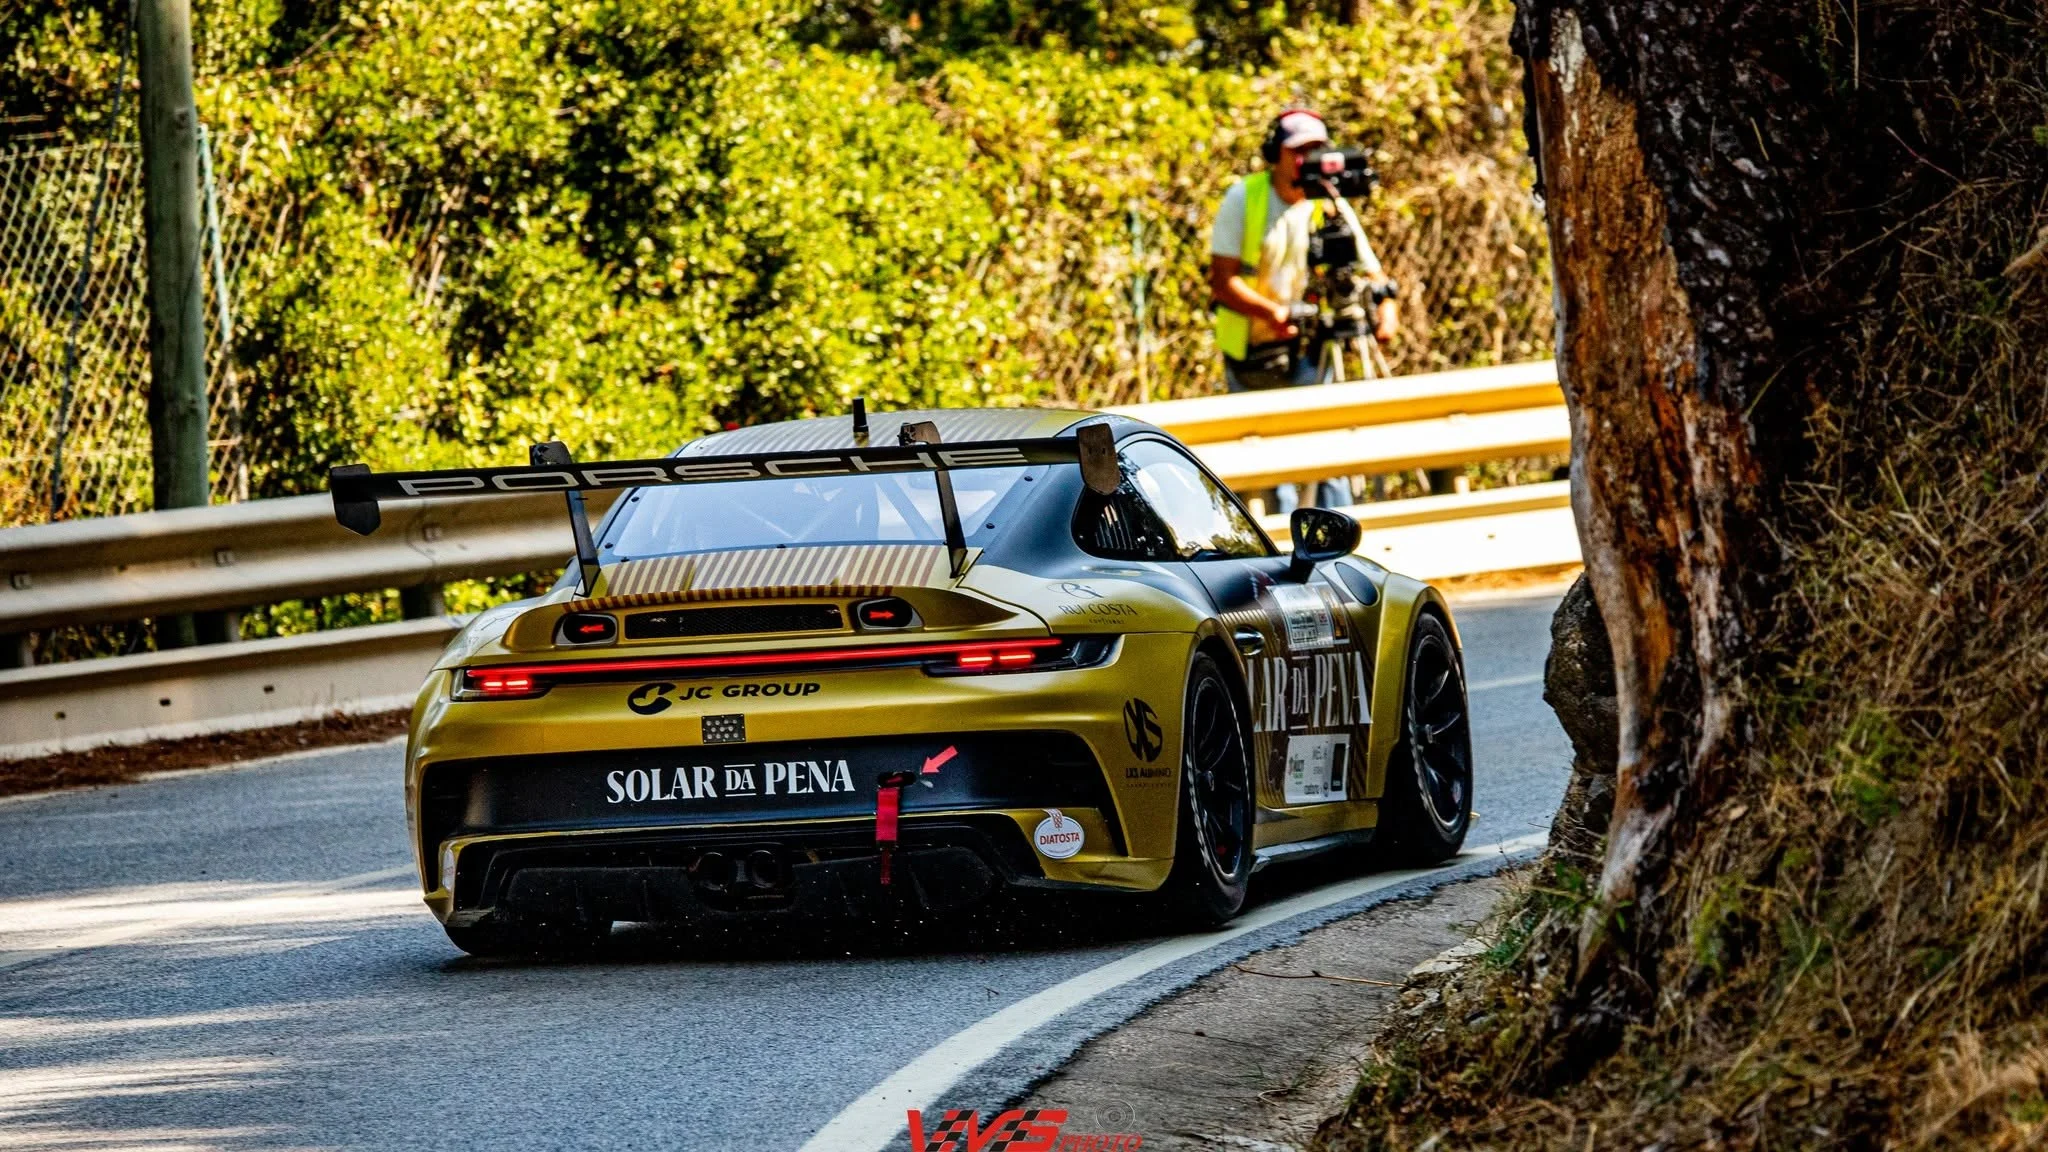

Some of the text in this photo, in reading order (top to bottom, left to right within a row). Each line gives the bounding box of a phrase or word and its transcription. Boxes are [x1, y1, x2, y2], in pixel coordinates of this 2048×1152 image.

[398, 447, 1028, 496] PORSCHE
[1058, 603, 1138, 616] RUI COSTA
[679, 682, 821, 701] JC GROUP
[1247, 651, 1374, 733] LAR DA PENA
[606, 759, 856, 804] SOLAR DA PENA
[1039, 832, 1081, 846] DIATOSTA
